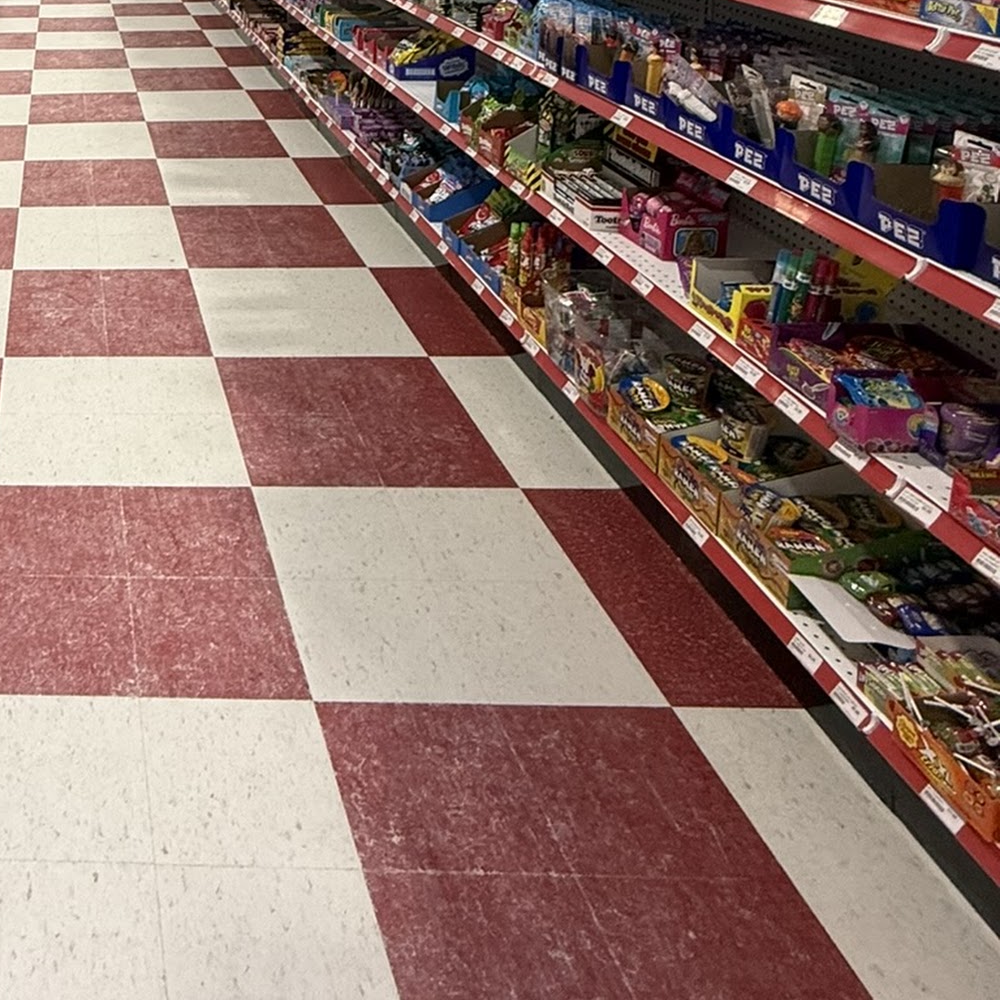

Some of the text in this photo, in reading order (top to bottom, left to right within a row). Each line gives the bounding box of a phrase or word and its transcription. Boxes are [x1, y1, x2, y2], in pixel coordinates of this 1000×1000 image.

[588, 75, 609, 95] PEZ
[634, 95, 658, 116] PEZ
[833, 103, 857, 118] PEZ
[679, 115, 705, 140] PEZ
[871, 117, 899, 132] PEZ
[734, 142, 767, 171] PEZ
[959, 149, 991, 165] PEZ
[798, 174, 836, 206] PEZ
[878, 211, 925, 250] PEZ
